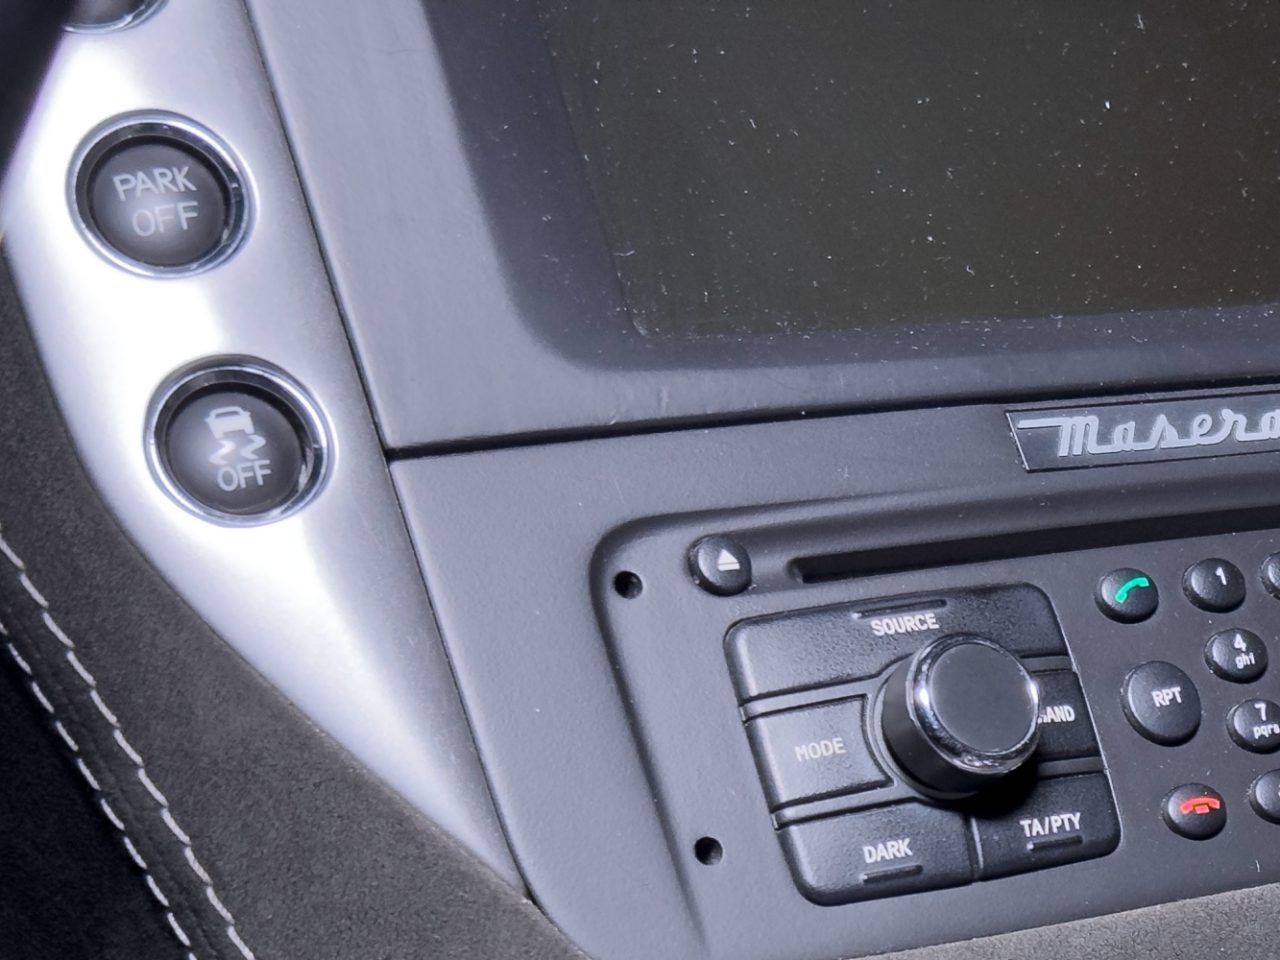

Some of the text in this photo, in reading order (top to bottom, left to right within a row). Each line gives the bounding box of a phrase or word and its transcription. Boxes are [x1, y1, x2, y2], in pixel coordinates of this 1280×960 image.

[112, 166, 197, 200] PARK
[132, 201, 198, 236] OFF
[216, 459, 272, 492] OFF
[1216, 567, 1227, 586] 1
[871, 613, 939, 636] SOURCE
[1234, 633, 1247, 652] 4
[1151, 686, 1182, 707] RPT
[1254, 703, 1267, 721] 7
[795, 738, 846, 761] MODE
[1019, 813, 1081, 837] TA/PTY
[863, 839, 912, 863] DARK
